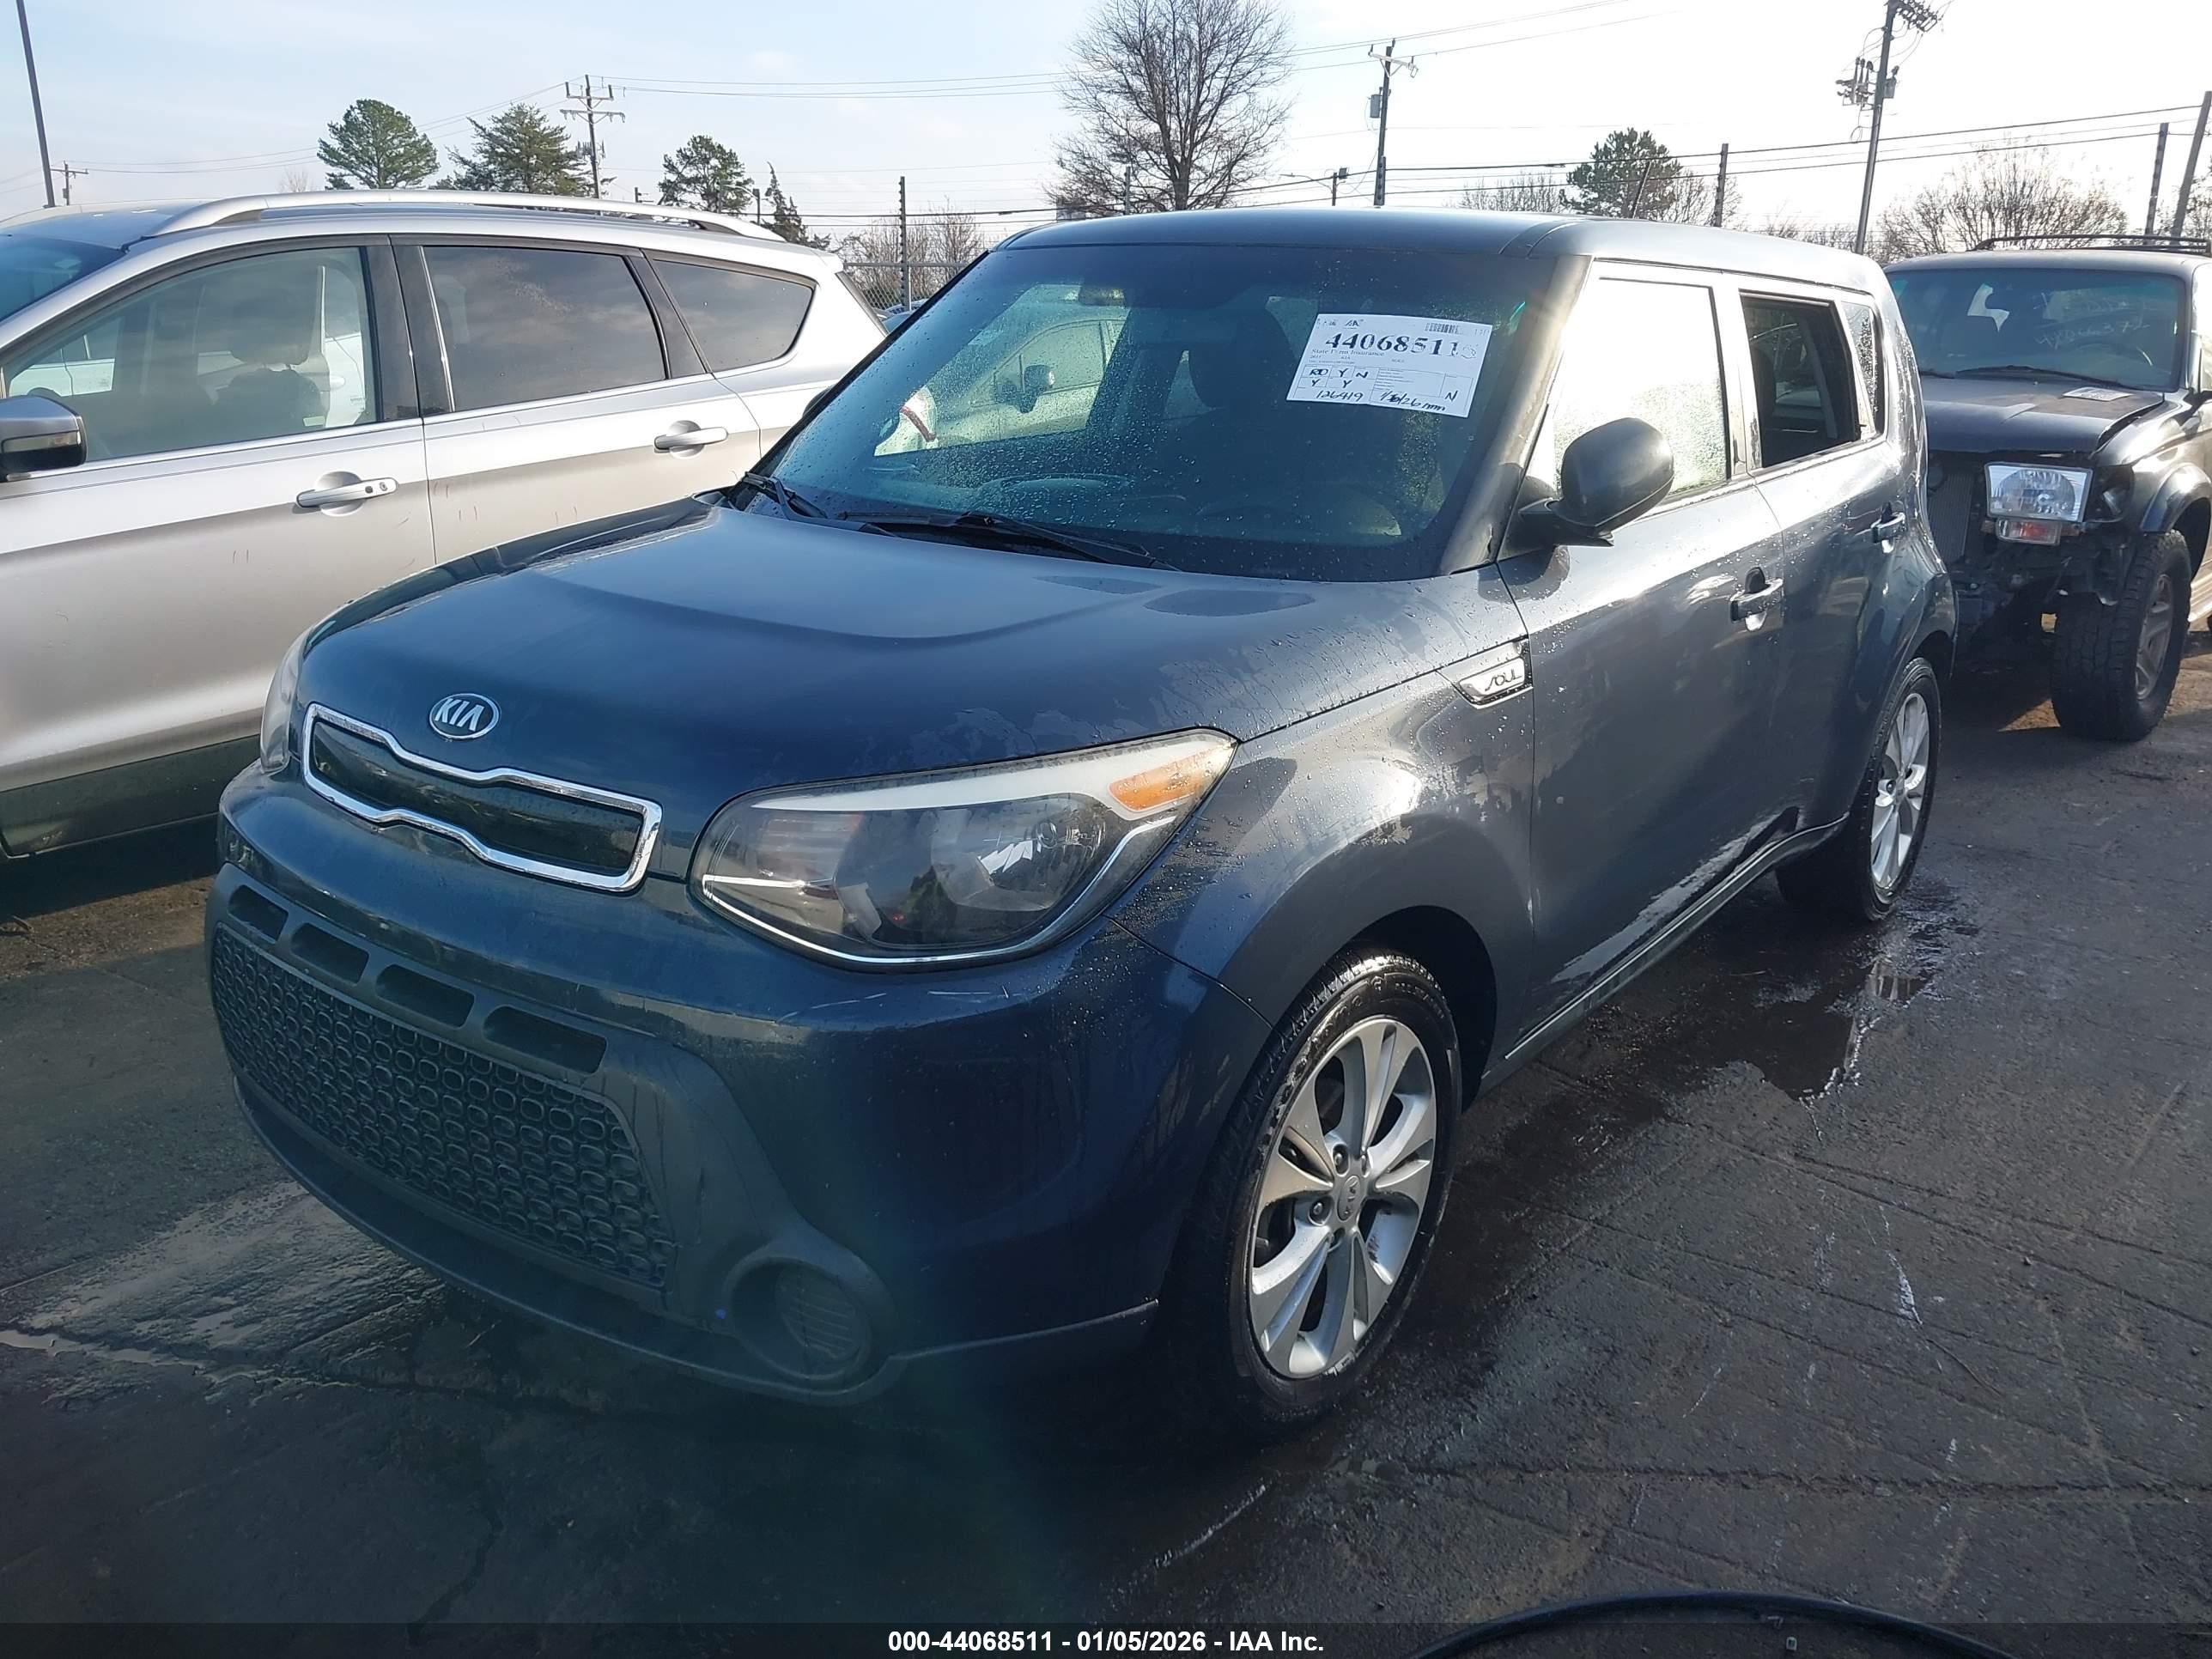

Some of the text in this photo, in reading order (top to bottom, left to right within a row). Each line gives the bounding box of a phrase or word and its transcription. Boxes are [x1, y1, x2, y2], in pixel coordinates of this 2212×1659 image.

[1338, 368, 1350, 378] Y
[1311, 378, 1352, 389] Y Y
[1444, 390, 1459, 402] N
[1484, 669, 1522, 692] SOUL
[434, 696, 485, 732] KIA
